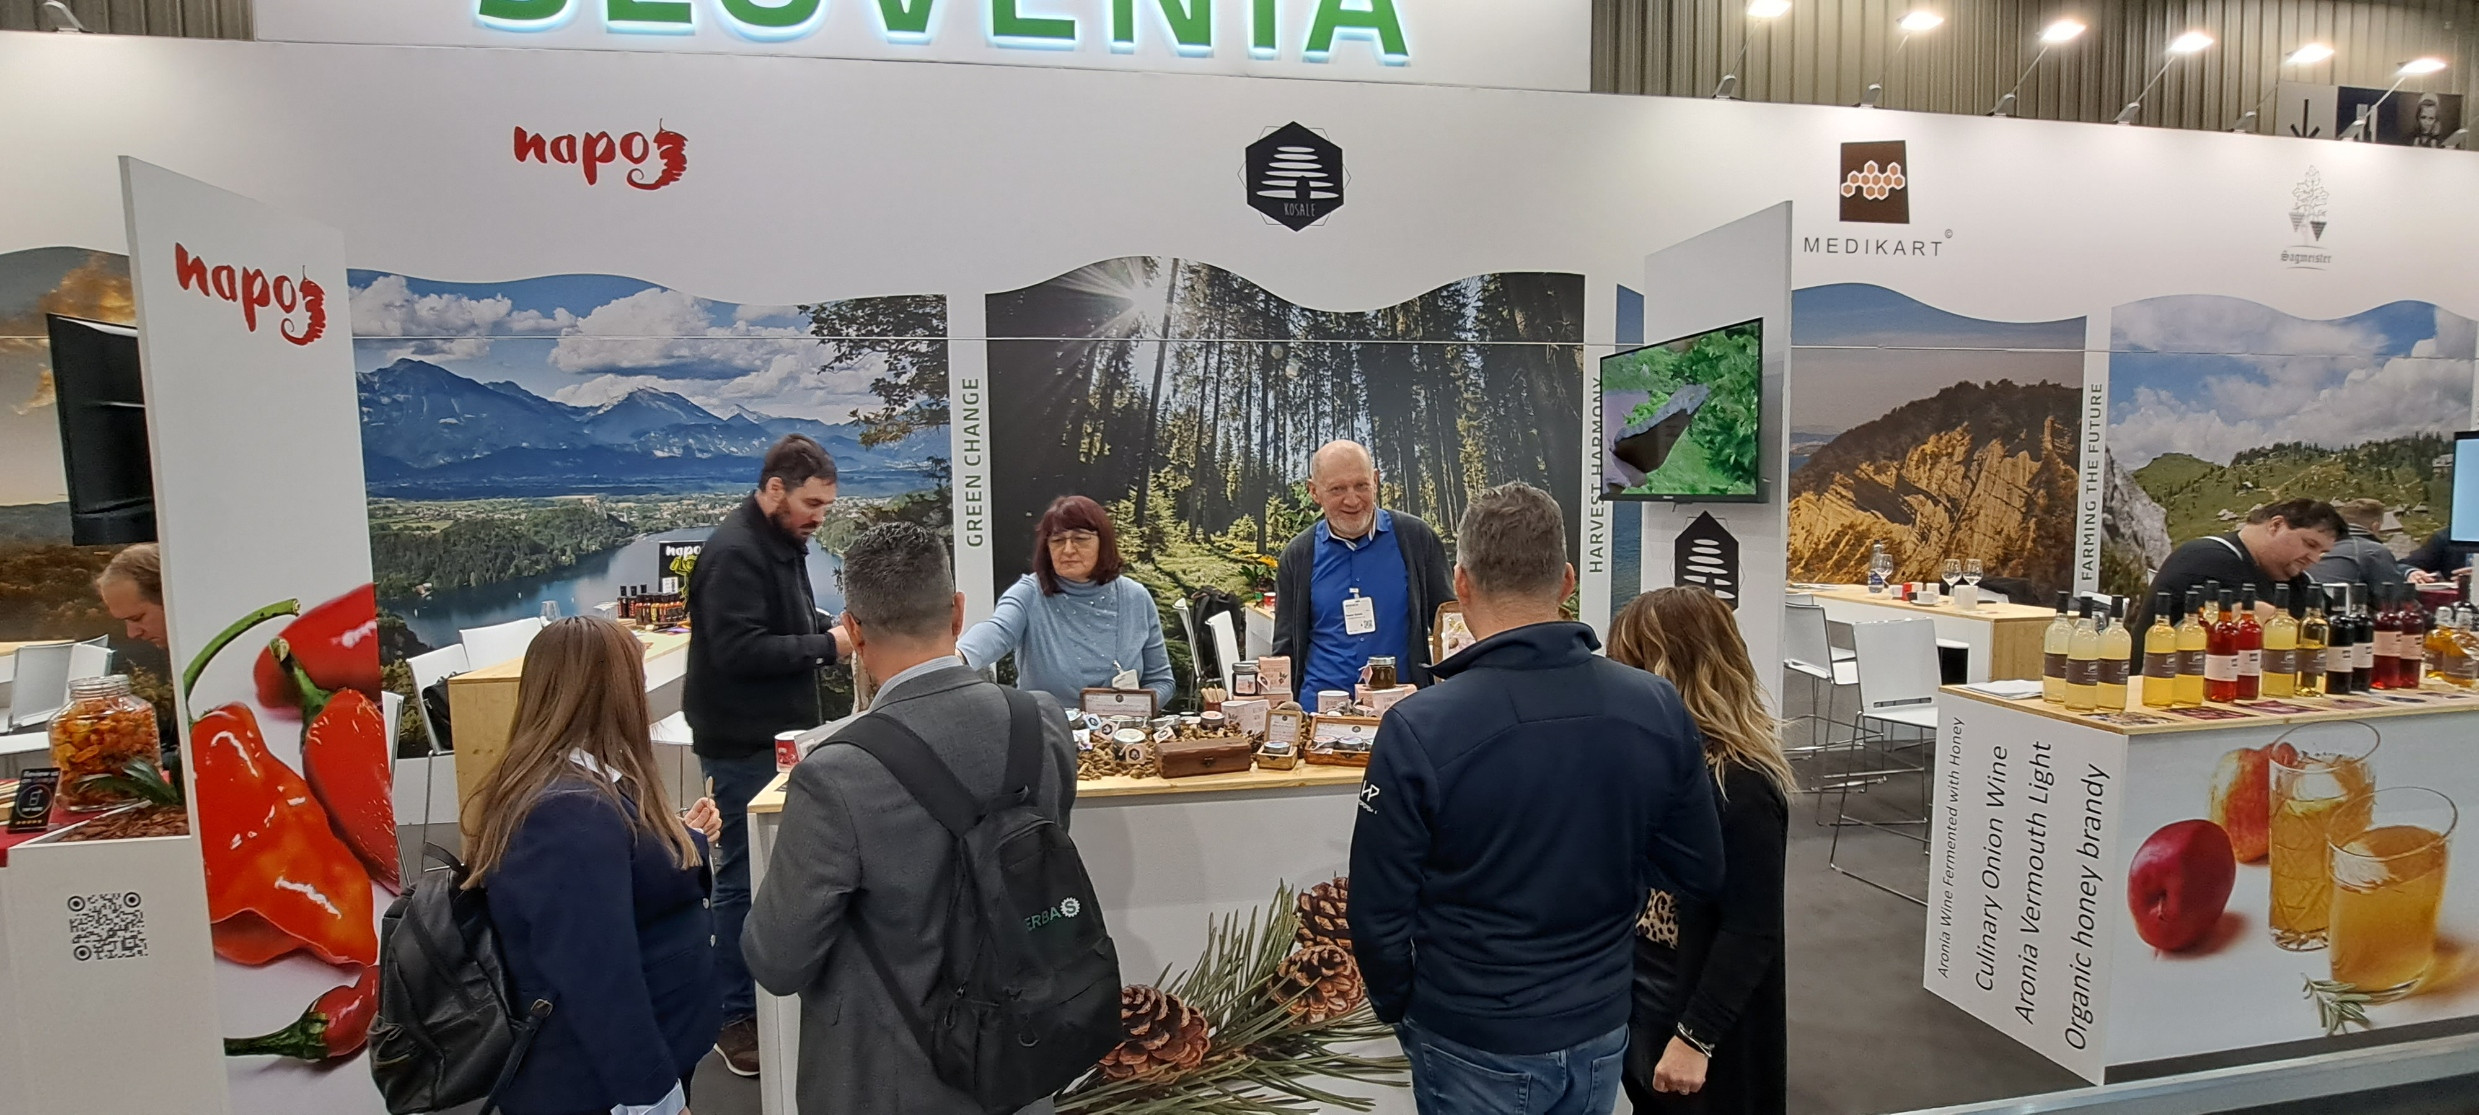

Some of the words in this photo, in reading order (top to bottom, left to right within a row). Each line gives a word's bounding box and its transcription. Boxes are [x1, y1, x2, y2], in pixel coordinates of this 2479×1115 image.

[1283, 202, 1315, 217] KOSALE
[1803, 237, 1943, 256] MEDIKART
[962, 378, 982, 466] CHANGE
[2088, 383, 2102, 454] FUTURE
[965, 475, 983, 547] GREEN
[2086, 459, 2099, 494] THE
[1589, 483, 1604, 573] HARVEST
[2082, 500, 2097, 581] FARMING
[1951, 717, 1965, 767] Honey
[1986, 745, 2008, 808] Wine
[2028, 741, 2055, 804] Light
[1948, 770, 1959, 803] with
[2076, 762, 2111, 860] brandy
[1943, 806, 1958, 887] Fermented
[1982, 816, 2004, 890] Onion
[2020, 811, 2048, 935] Vermouth
[1940, 889, 1953, 926] Wine
[2070, 864, 2103, 948] honey
[1938, 931, 1951, 979] Aronia
[1976, 894, 2003, 992] Culinary
[2015, 943, 2039, 1025] Aronia
[2065, 952, 2094, 1051] Organic
